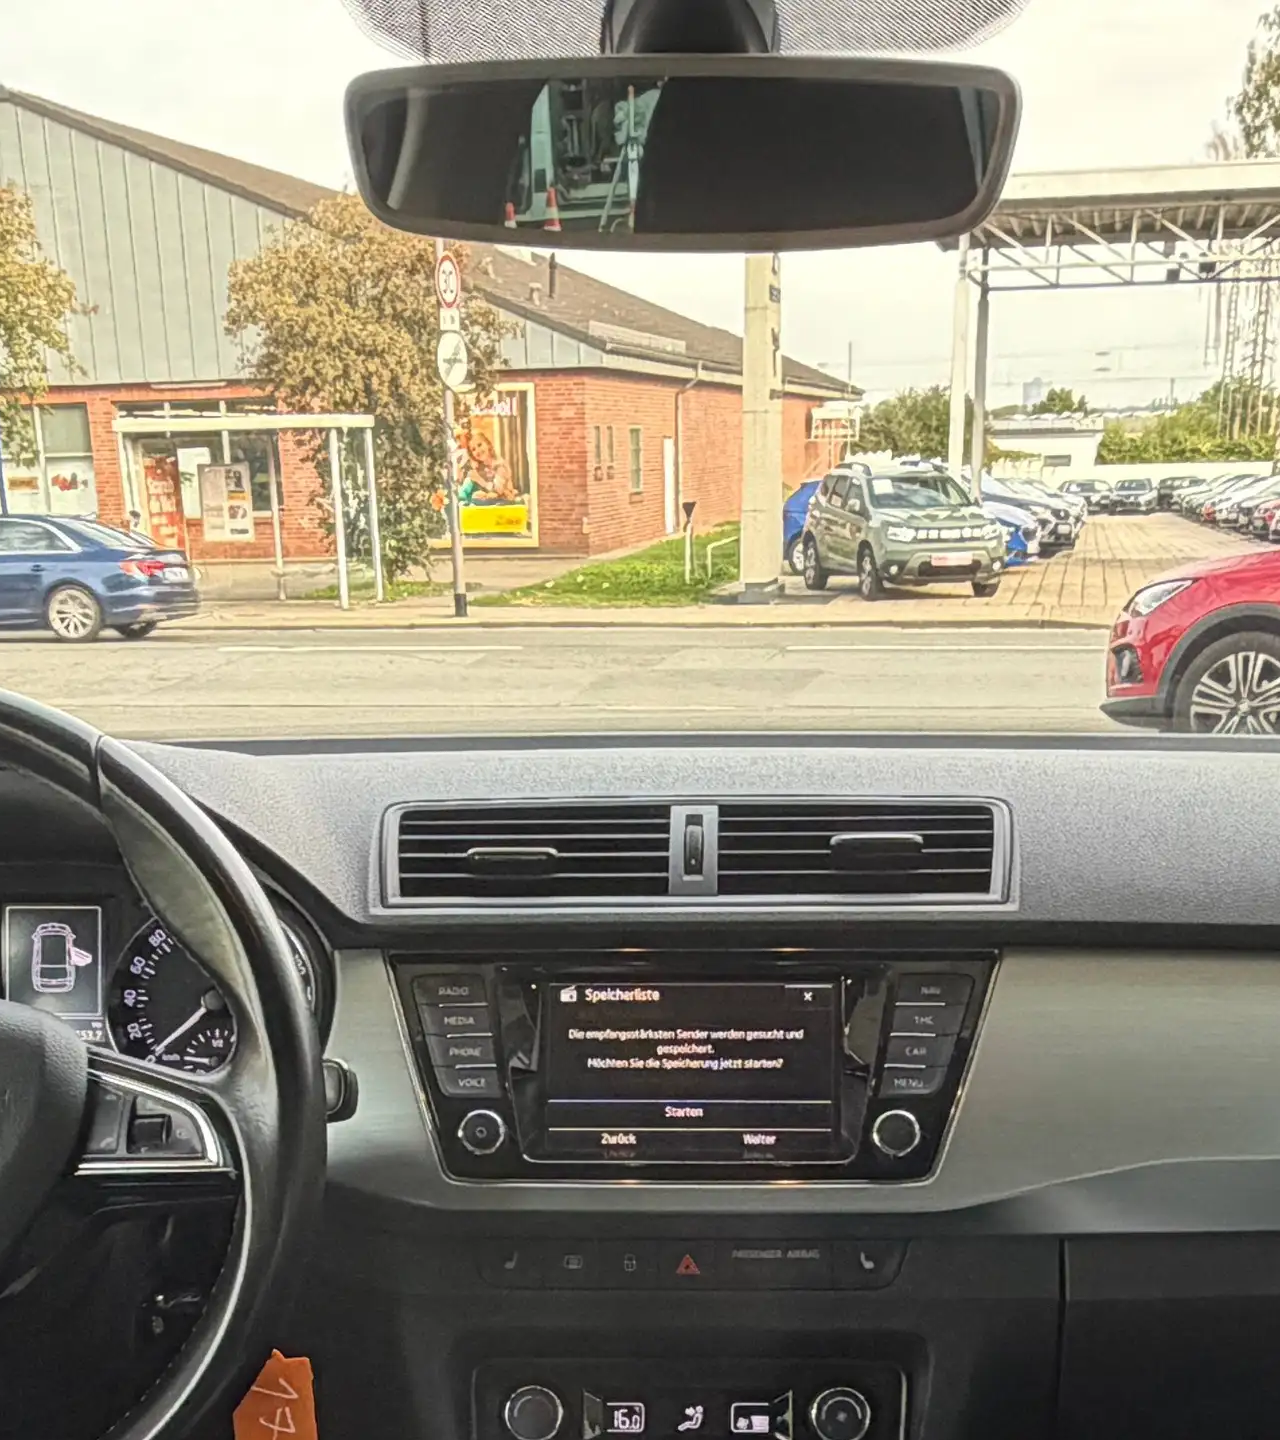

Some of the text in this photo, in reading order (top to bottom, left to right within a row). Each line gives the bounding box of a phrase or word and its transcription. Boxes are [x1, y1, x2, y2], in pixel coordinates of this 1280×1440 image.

[148, 928, 167, 948] 80
[130, 955, 146, 976] 60
[438, 986, 470, 996] RADIO
[584, 987, 661, 1003] Speicherliste
[123, 988, 137, 1008] 40
[443, 1016, 476, 1026] MEDIA
[126, 1021, 143, 1042] 20
[568, 1028, 804, 1042] Die empfangsstärksten Sender werden gesucht und
[449, 1046, 482, 1057] PHONE
[656, 1043, 715, 1056] gespeichert.
[905, 1047, 927, 1057] CAR
[587, 1057, 784, 1071] Möchten Sie die Speicherung jetzt starten?
[665, 1105, 704, 1118] Starten
[601, 1132, 637, 1145] Zurück
[743, 1133, 777, 1145] Weiter
